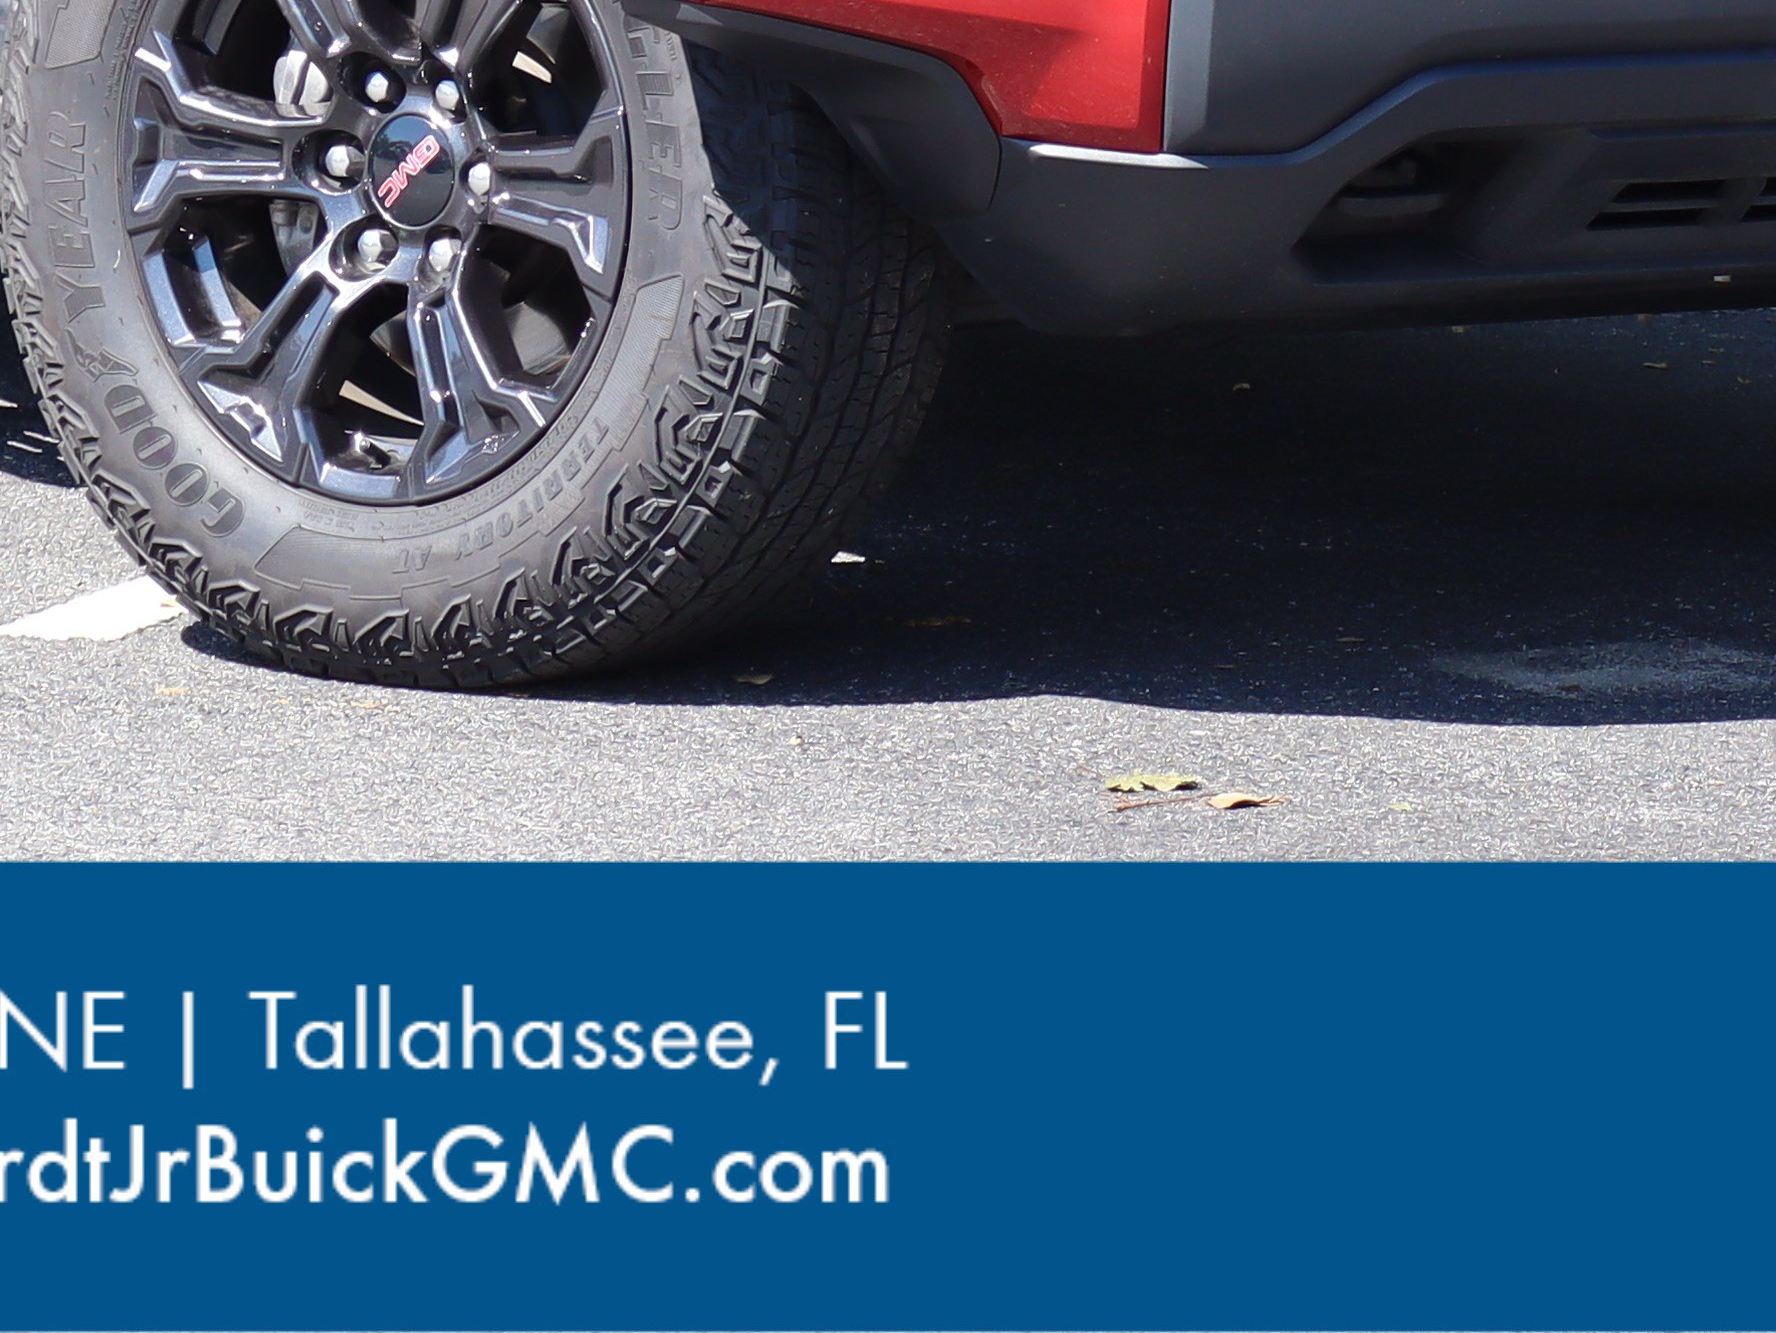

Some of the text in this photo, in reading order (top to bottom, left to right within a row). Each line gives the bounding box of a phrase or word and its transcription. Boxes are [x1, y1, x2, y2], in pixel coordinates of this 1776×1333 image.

[377, 134, 441, 209] GMC
[454, 415, 611, 562] TERRITORY
[391, 544, 434, 575] AT
